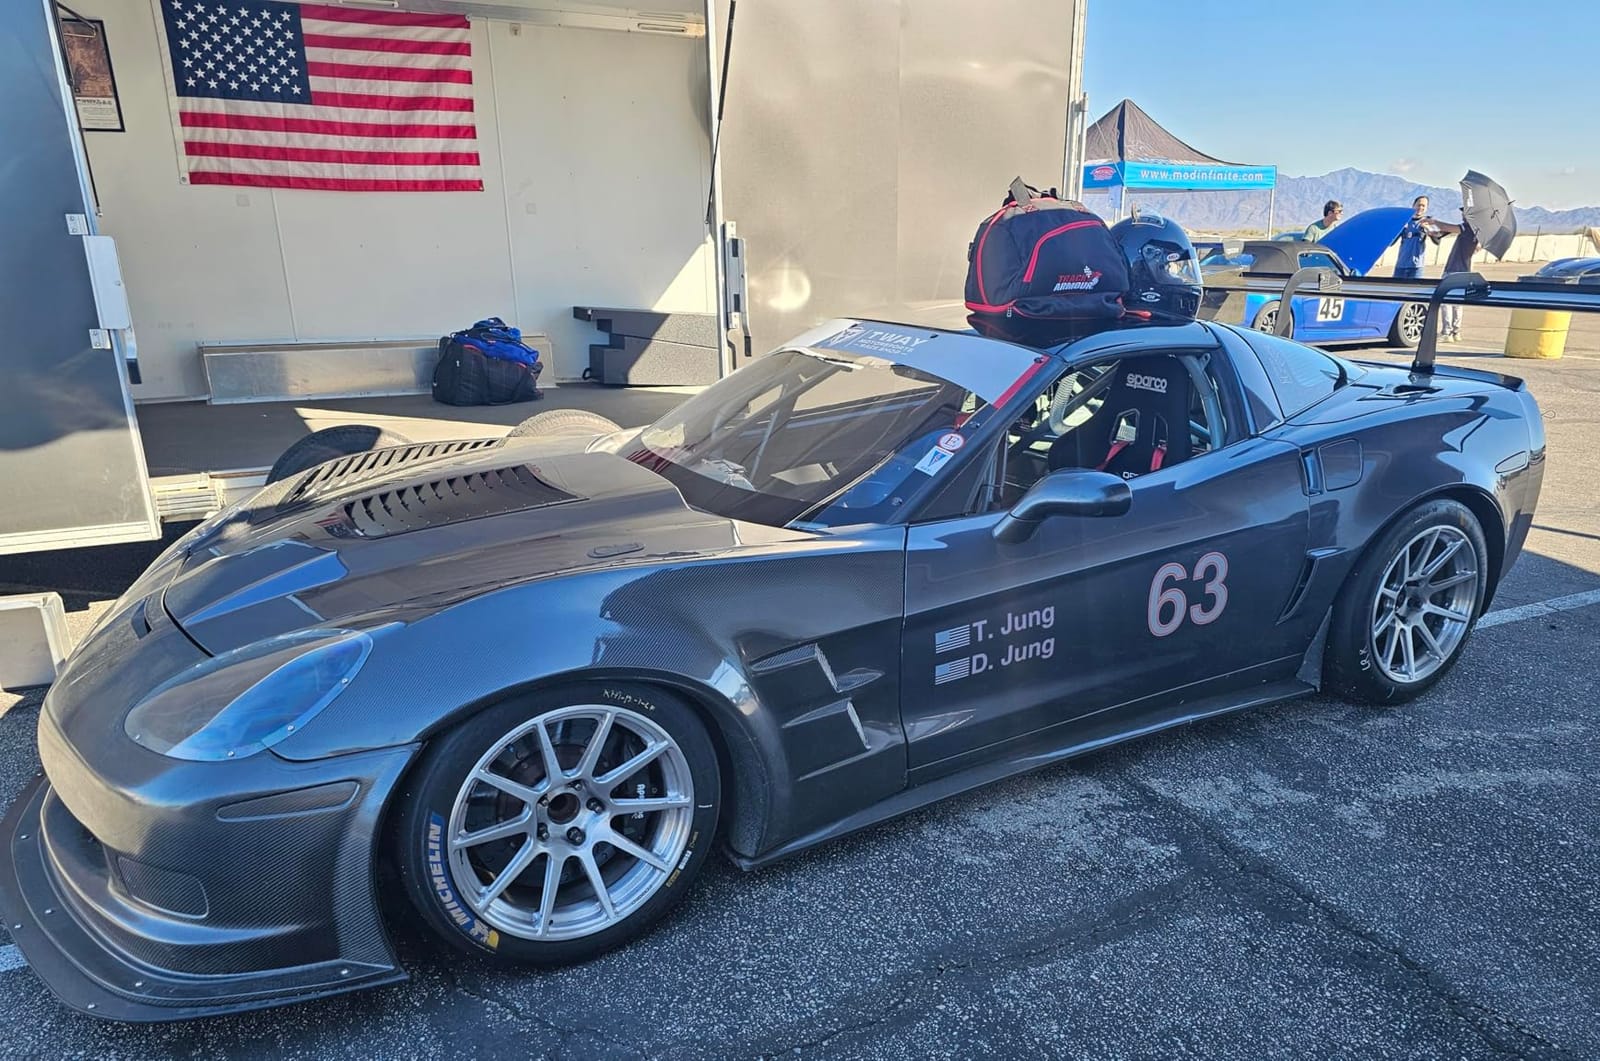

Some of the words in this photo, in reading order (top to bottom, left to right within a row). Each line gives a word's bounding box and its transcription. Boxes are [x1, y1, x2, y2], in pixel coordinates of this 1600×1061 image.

[1140, 168, 1263, 182] www.modinfinite.com
[1053, 281, 1094, 292] ARMOUR
[1057, 274, 1089, 282] TRACK
[1320, 298, 1342, 319] 45
[868, 331, 929, 347] TWAY
[1125, 373, 1168, 392] sparco
[1147, 551, 1229, 637] 63
[972, 620, 993, 642] T.
[1000, 606, 1055, 635] Jung
[971, 653, 993, 675] D.
[1000, 638, 1055, 666] Jung
[428, 823, 471, 926] MICHELIN
